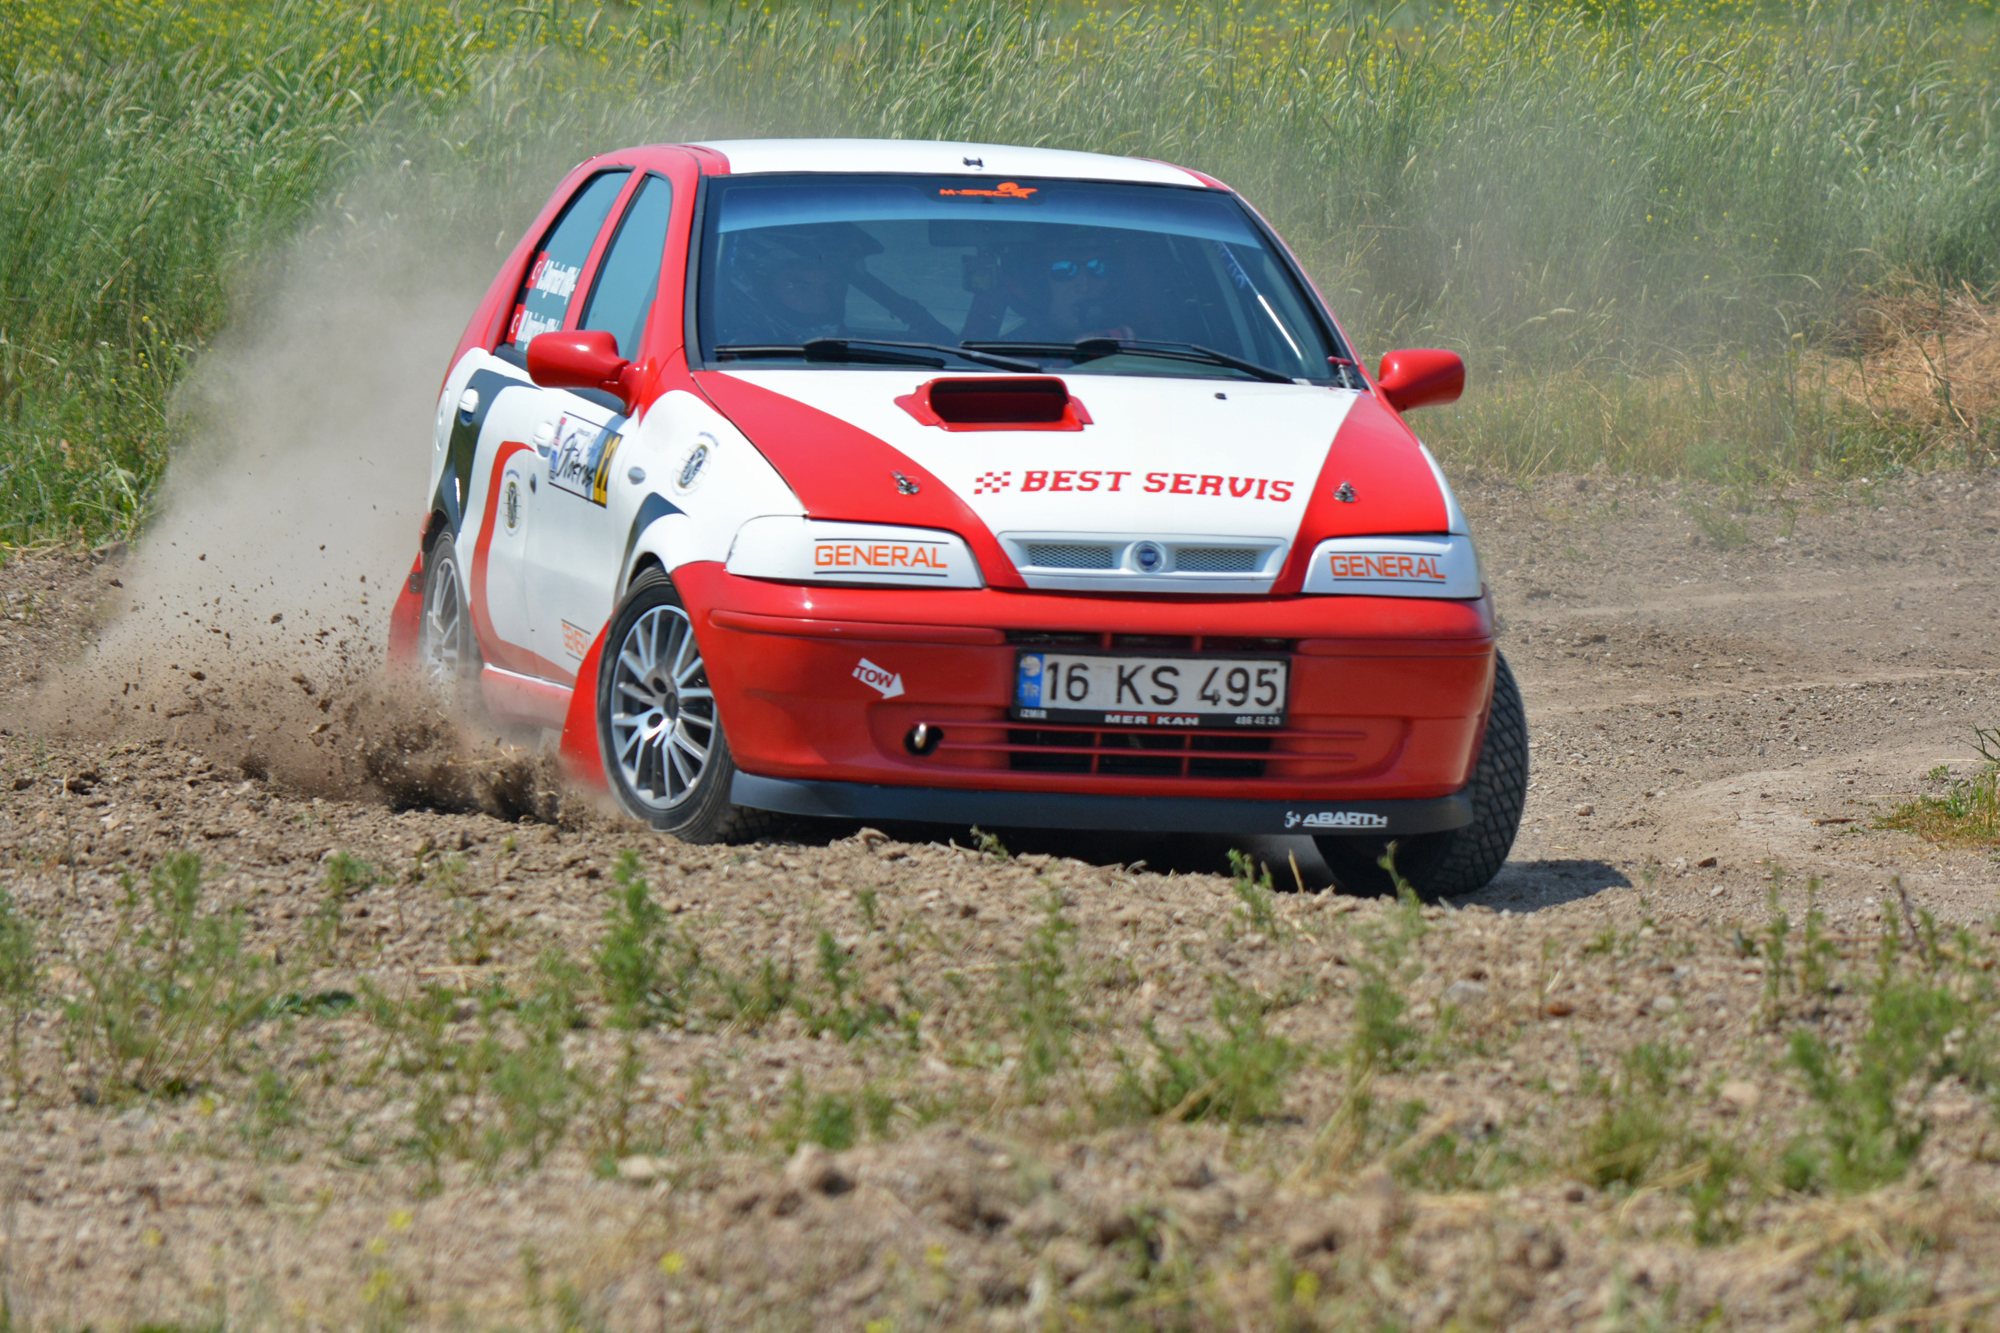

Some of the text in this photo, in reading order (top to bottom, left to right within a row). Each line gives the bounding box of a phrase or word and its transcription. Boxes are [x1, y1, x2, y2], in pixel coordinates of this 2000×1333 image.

[1020, 470, 1296, 503] BEST SERVIS
[815, 544, 948, 568] GENERAL
[1330, 555, 1446, 579] GENERAL
[856, 664, 894, 689] TOW
[1046, 661, 1278, 707] 16 KS 495
[1303, 811, 1388, 826] ABARTH
